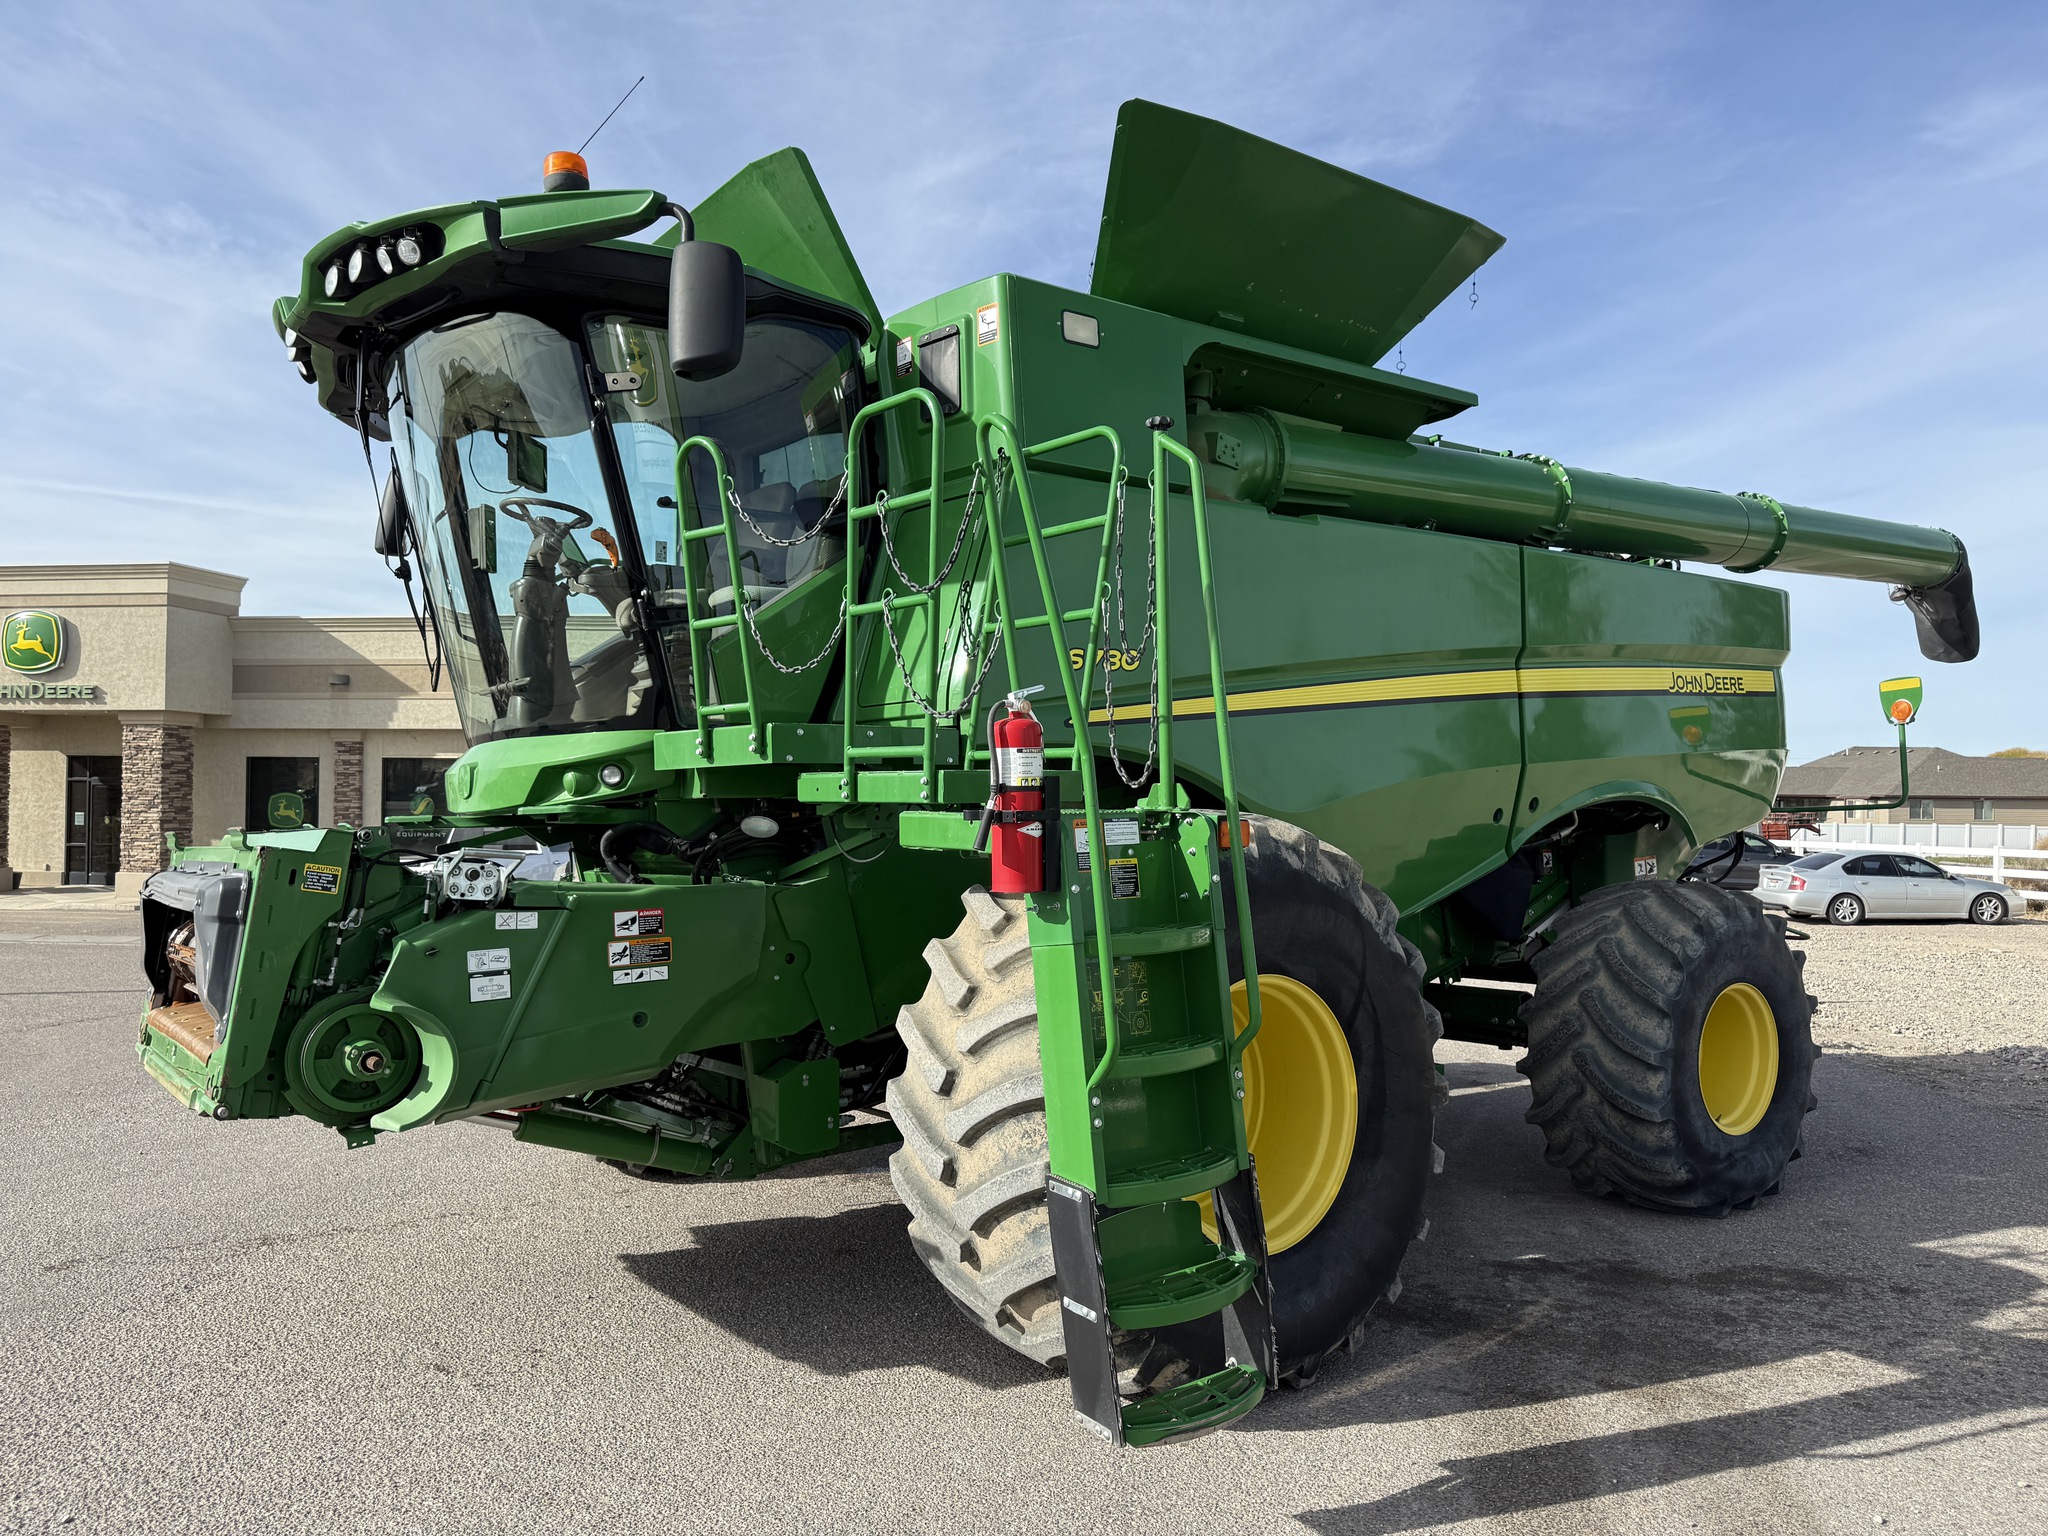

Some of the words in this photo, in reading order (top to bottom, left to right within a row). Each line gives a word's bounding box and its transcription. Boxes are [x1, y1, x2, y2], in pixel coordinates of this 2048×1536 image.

[1669, 671, 1703, 690] JOHN
[1704, 673, 1745, 691] DEERE
[28, 682, 94, 699] DEERE
[311, 864, 341, 873] CAUTION
